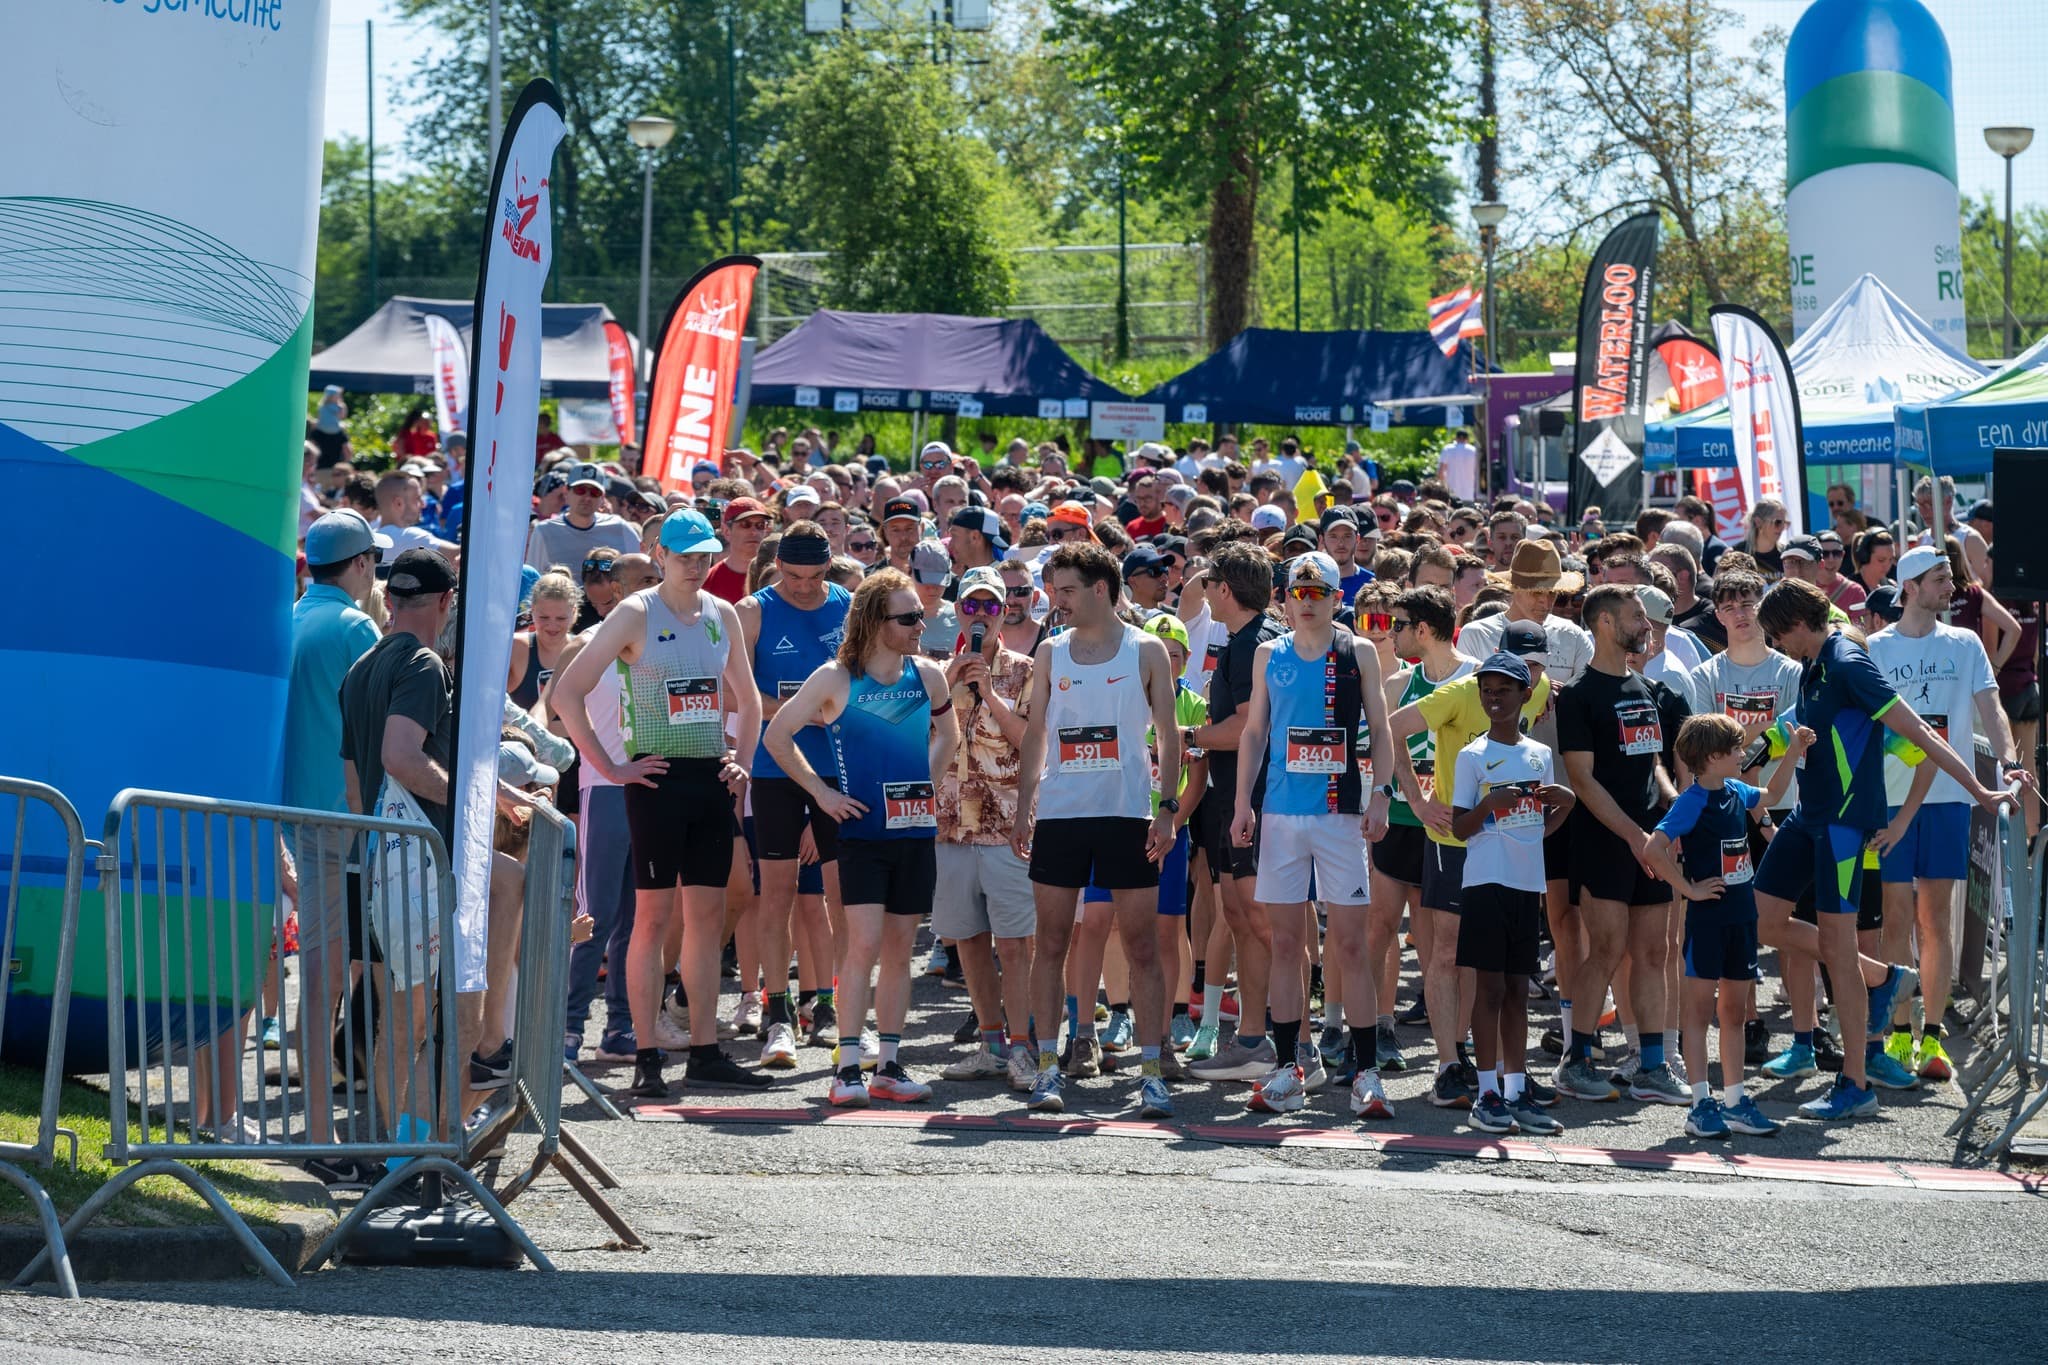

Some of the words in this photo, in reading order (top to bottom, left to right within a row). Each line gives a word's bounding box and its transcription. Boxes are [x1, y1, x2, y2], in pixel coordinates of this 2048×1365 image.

[1637, 308, 1647, 321] of
[1635, 322, 1645, 345] land
[1581, 263, 1637, 422] WATERLOO
[1634, 345, 1644, 362] the
[863, 395, 899, 407] RODE
[1294, 411, 1331, 422] RODE
[1978, 424, 2015, 448] Een
[1702, 442, 1729, 458] Een
[1819, 436, 1892, 457] gemeente
[1889, 664, 1913, 681] 10
[1920, 659, 1937, 676] lat
[680, 696, 711, 711] 1559
[858, 690, 923, 703] EXCELSIOR
[1075, 743, 1102, 760] 591
[1299, 747, 1333, 762] 840
[838, 737, 849, 796] RUSSELS
[899, 801, 928, 817] 1145
